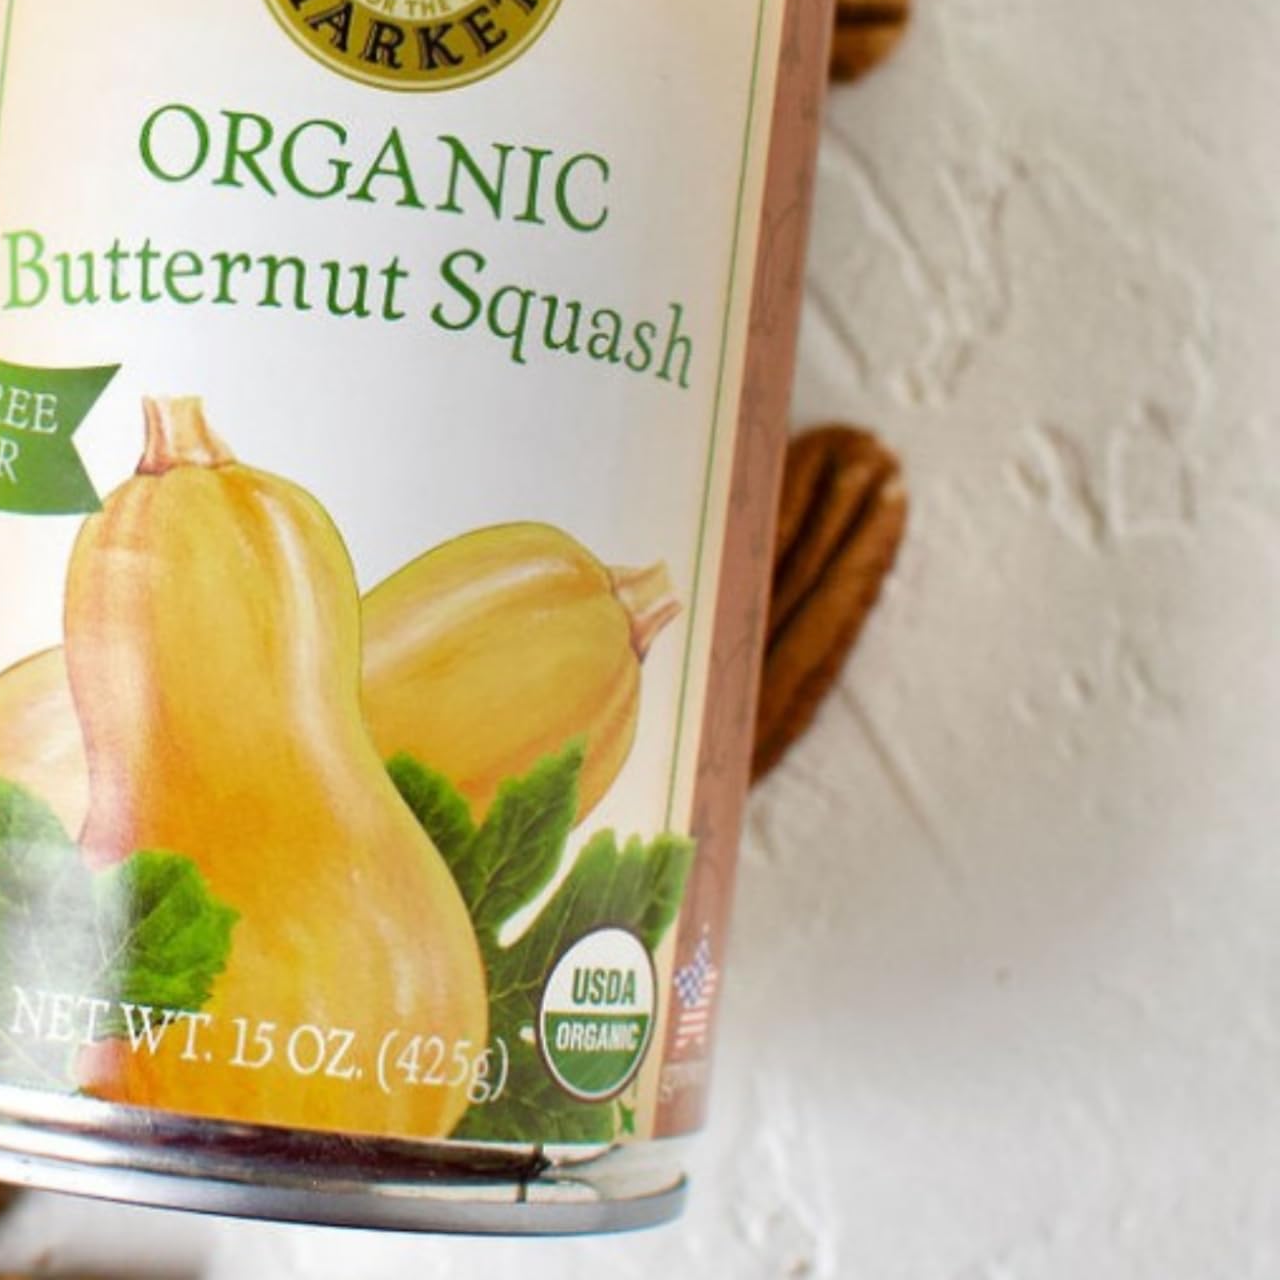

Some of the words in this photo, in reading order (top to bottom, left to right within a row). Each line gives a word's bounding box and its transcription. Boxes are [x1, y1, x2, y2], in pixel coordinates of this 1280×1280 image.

[138, 104, 612, 232] ORGANIC
[1, 229, 410, 321] Butternut
[429, 248, 693, 389] Squash
[10, 985, 110, 1043] NET
[120, 1003, 213, 1064] WT.
[229, 1018, 276, 1069] 15
[286, 1023, 365, 1080] OZ.
[376, 1028, 511, 1104] (425g)
[555, 1019, 641, 1052] ORGANIC
[573, 967, 636, 1006] USDA
